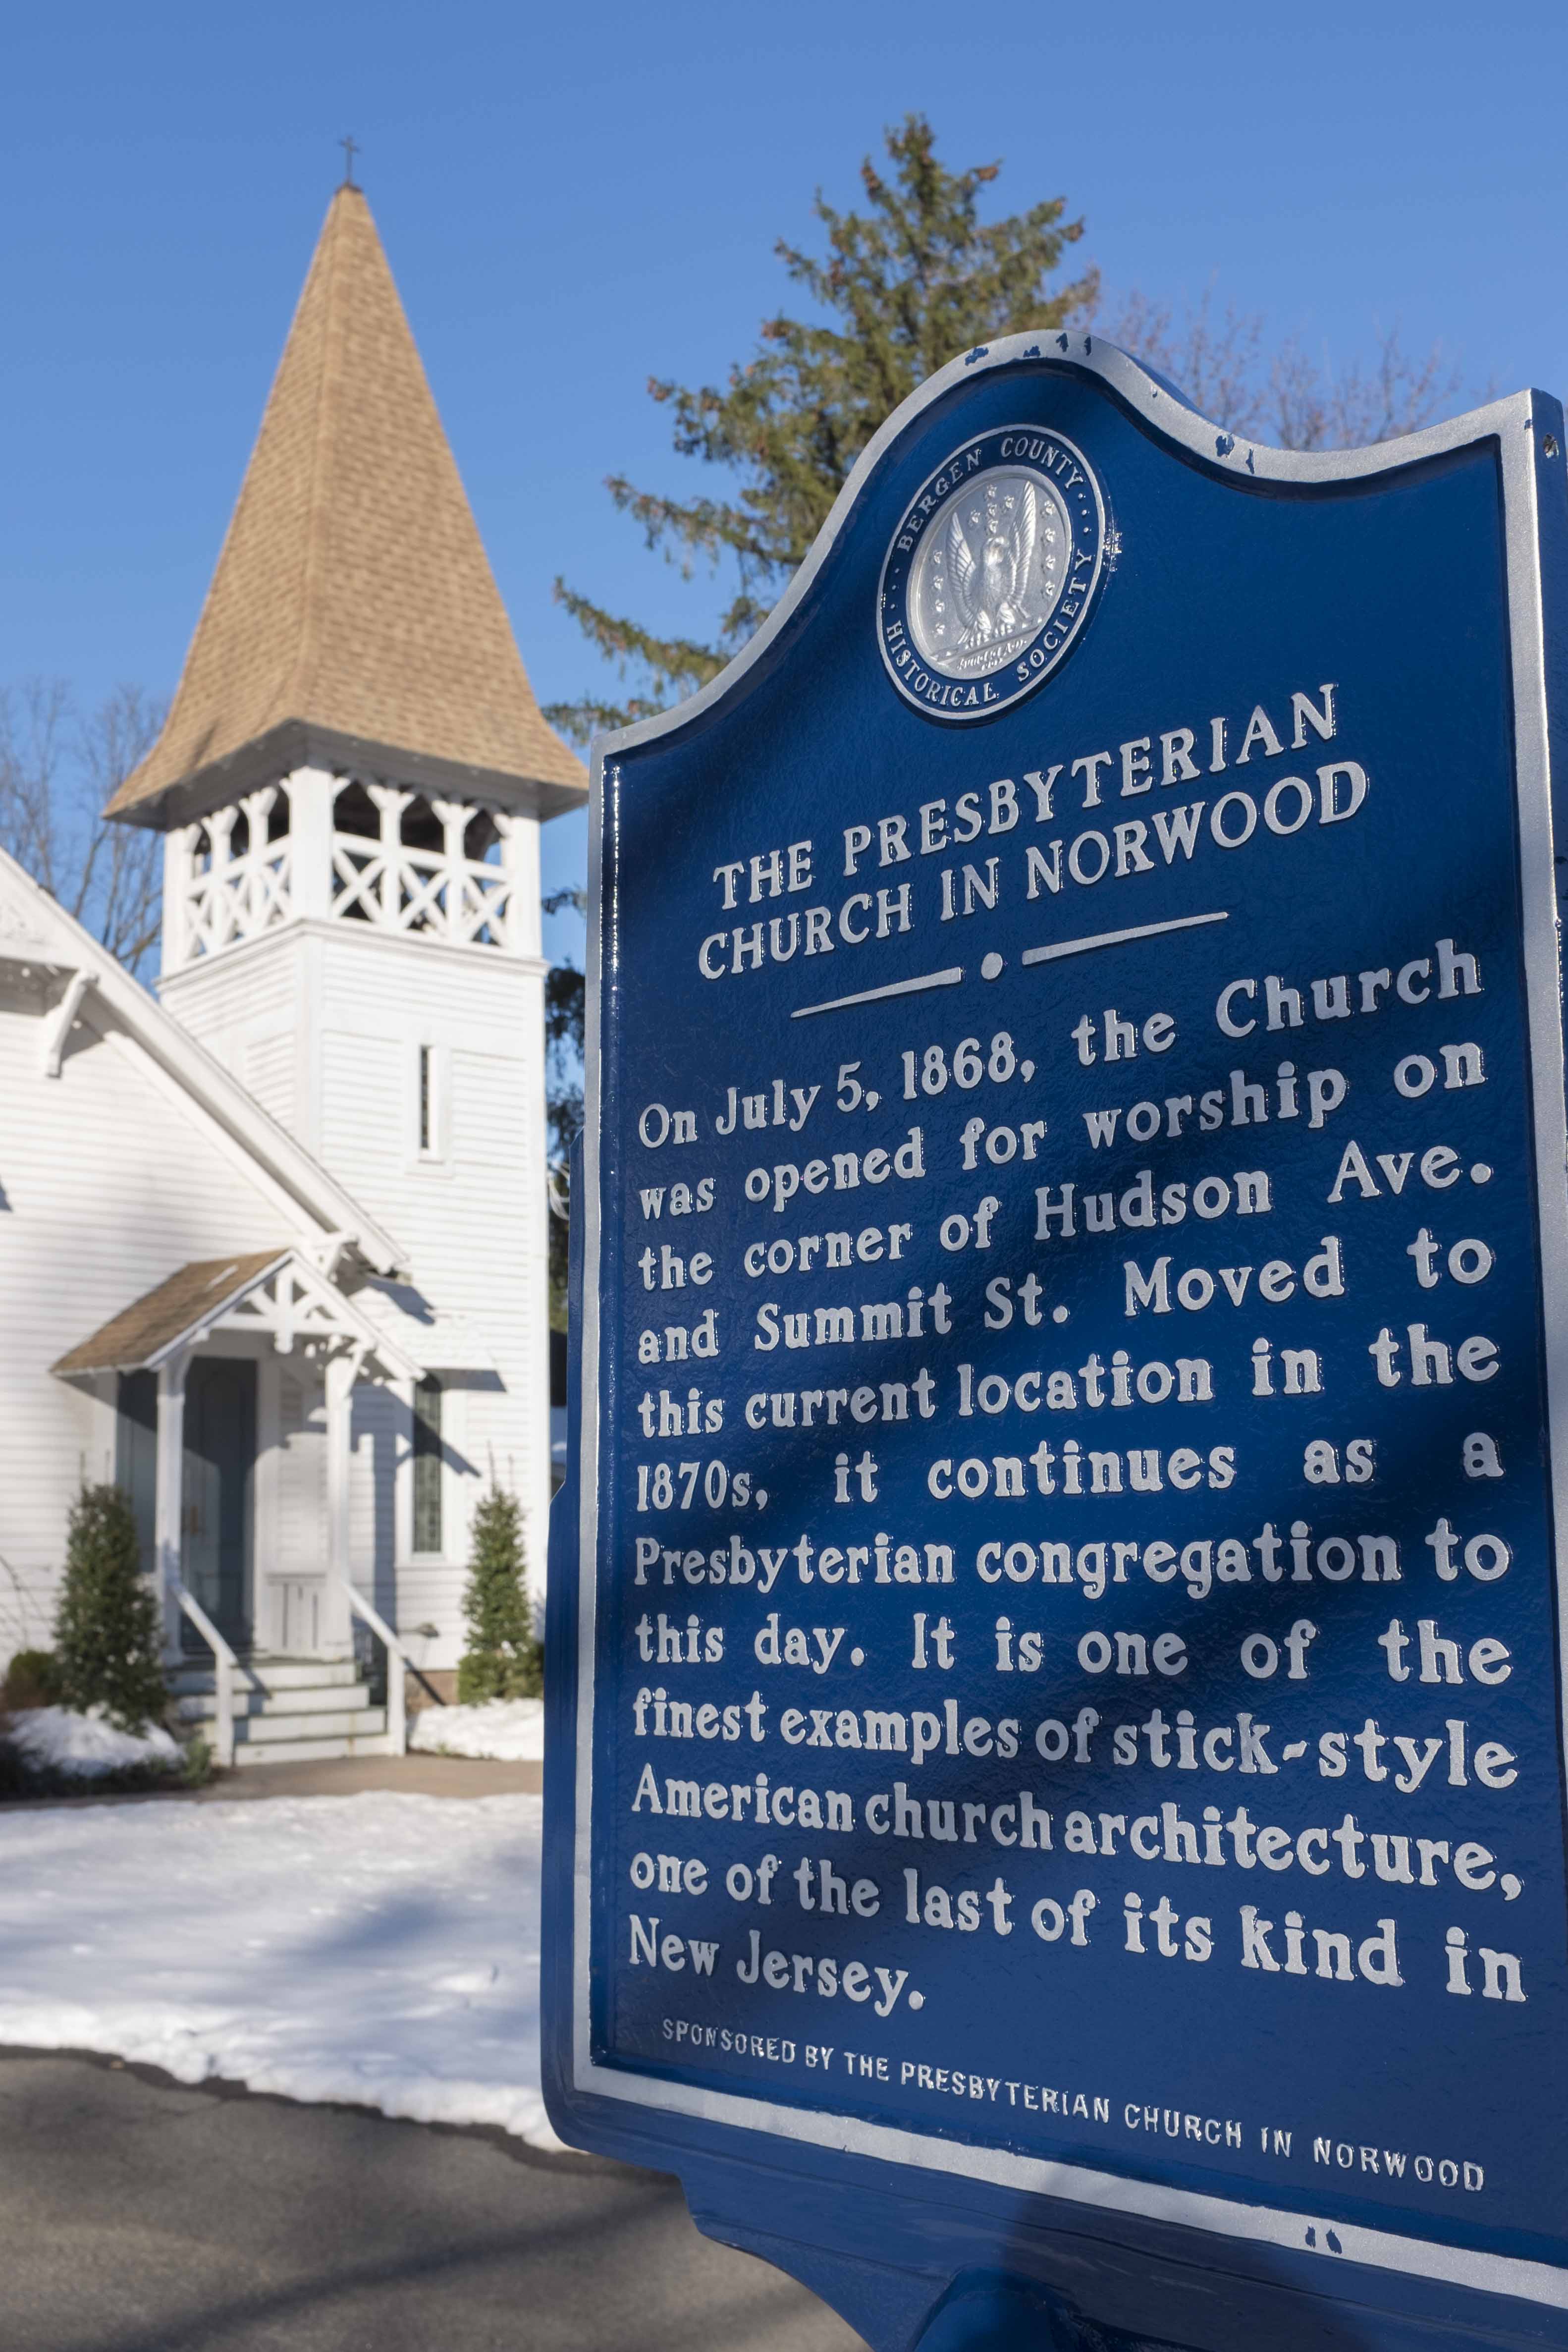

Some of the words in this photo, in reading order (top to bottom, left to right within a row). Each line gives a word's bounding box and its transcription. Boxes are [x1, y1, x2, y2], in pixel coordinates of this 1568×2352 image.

[897, 447, 981, 552] BERGEN
[1001, 437, 1082, 490] COUNTY
[887, 619, 999, 707] HISTORICAL
[1017, 548, 1091, 682] SOCIETY
[713, 840, 812, 909] THE
[844, 684, 1337, 876] PRESBYTERIAN
[699, 883, 911, 979] CHURCH
[941, 857, 999, 920] IN
[1026, 762, 1366, 899] NORWOOD
[639, 1103, 697, 1148] On
[716, 1080, 820, 1134] July
[837, 1062, 878, 1111] 5,
[902, 1032, 1034, 1099] 1868,
[1071, 1009, 1175, 1065] the
[1216, 939, 1481, 1037] Church
[639, 1177, 713, 1219] was
[745, 1127, 926, 1212] opened
[960, 1118, 1044, 1170] for
[1083, 1062, 1347, 1149] worship
[1394, 1042, 1485, 1097] on
[638, 1245, 712, 1290] the
[744, 1223, 912, 1277] corner
[940, 1196, 999, 1251] of
[1034, 1170, 1272, 1240] Hudson
[1328, 1141, 1491, 1203] Ave.
[639, 1309, 719, 1364] and
[755, 1283, 952, 1351] Summit
[985, 1273, 1068, 1329] St.
[1124, 1236, 1344, 1316] Moved
[1407, 1228, 1493, 1288] to
[638, 1388, 723, 1438] this
[745, 1368, 935, 1429] current
[958, 1351, 1213, 1416] location
[1251, 1338, 1321, 1395] in
[1369, 1324, 1499, 1386] the
[637, 1460, 767, 1511] 1870s,
[835, 1451, 877, 1502] it
[928, 1440, 1237, 1499] continues
[1304, 1440, 1373, 1483] as
[1464, 1433, 1504, 1477] a
[635, 1532, 955, 1593] Presbyterian
[976, 1521, 1401, 1599] congregation
[1426, 1518, 1509, 1581] to
[635, 1614, 723, 1663] this
[755, 1613, 864, 1674] day.
[912, 1613, 954, 1669] It
[995, 1617, 1043, 1671] is
[1078, 1632, 1188, 1675] one
[1241, 1620, 1316, 1679] of
[1381, 1619, 1512, 1685] the
[633, 1688, 766, 1742] finest
[780, 1699, 1018, 1764] examples
[1036, 1708, 1099, 1762] of
[1114, 1709, 1519, 1793] stick-style
[632, 1763, 853, 1831] American
[865, 1782, 1053, 1850] church
[1065, 1802, 1521, 1900] architecture,
[630, 1853, 707, 1895] one
[726, 1855, 778, 1904] of
[794, 1858, 879, 1916] the
[904, 1868, 1012, 1935] last
[1031, 1889, 1095, 1946] of
[1124, 1892, 1215, 1962] its
[1240, 1905, 1406, 1986] kind
[1445, 1926, 1526, 2002] in
[630, 1914, 719, 1975] New
[737, 1930, 925, 2017] Jersey.
[663, 2020, 796, 2063] SPONSORED
[806, 2045, 834, 2070] BY
[844, 2052, 889, 2081] THE
[901, 2062, 1109, 2123] PRESBYTERIAN
[1125, 2104, 1242, 2148] CHURCH
[1261, 2127, 1292, 2157] IN
[1314, 2137, 1484, 2190] NORWOOD
